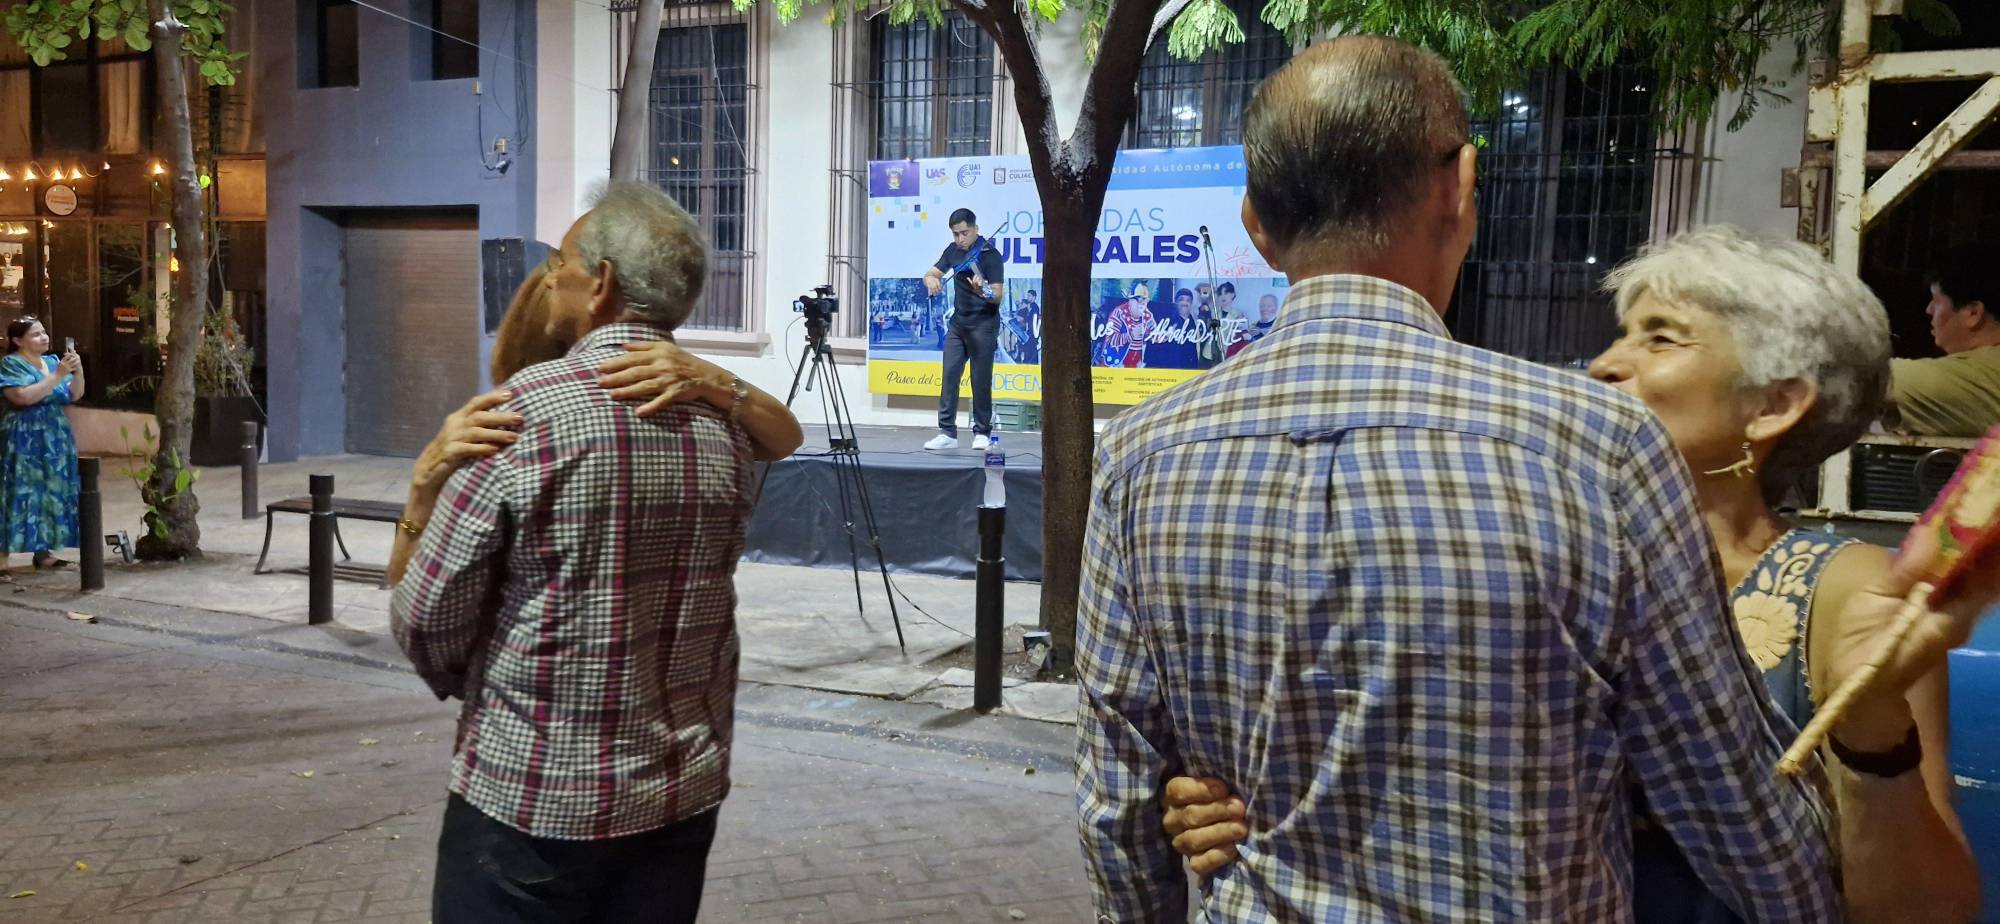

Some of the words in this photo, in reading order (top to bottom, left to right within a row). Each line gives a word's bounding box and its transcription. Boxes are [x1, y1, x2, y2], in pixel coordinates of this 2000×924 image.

[926, 168, 946, 179] UAS
[1154, 163, 1220, 173] Autónoma
[1227, 161, 1242, 170] de
[992, 234, 1201, 264] ULTRALES
[886, 371, 915, 384] Paseo
[918, 374, 935, 385] del
